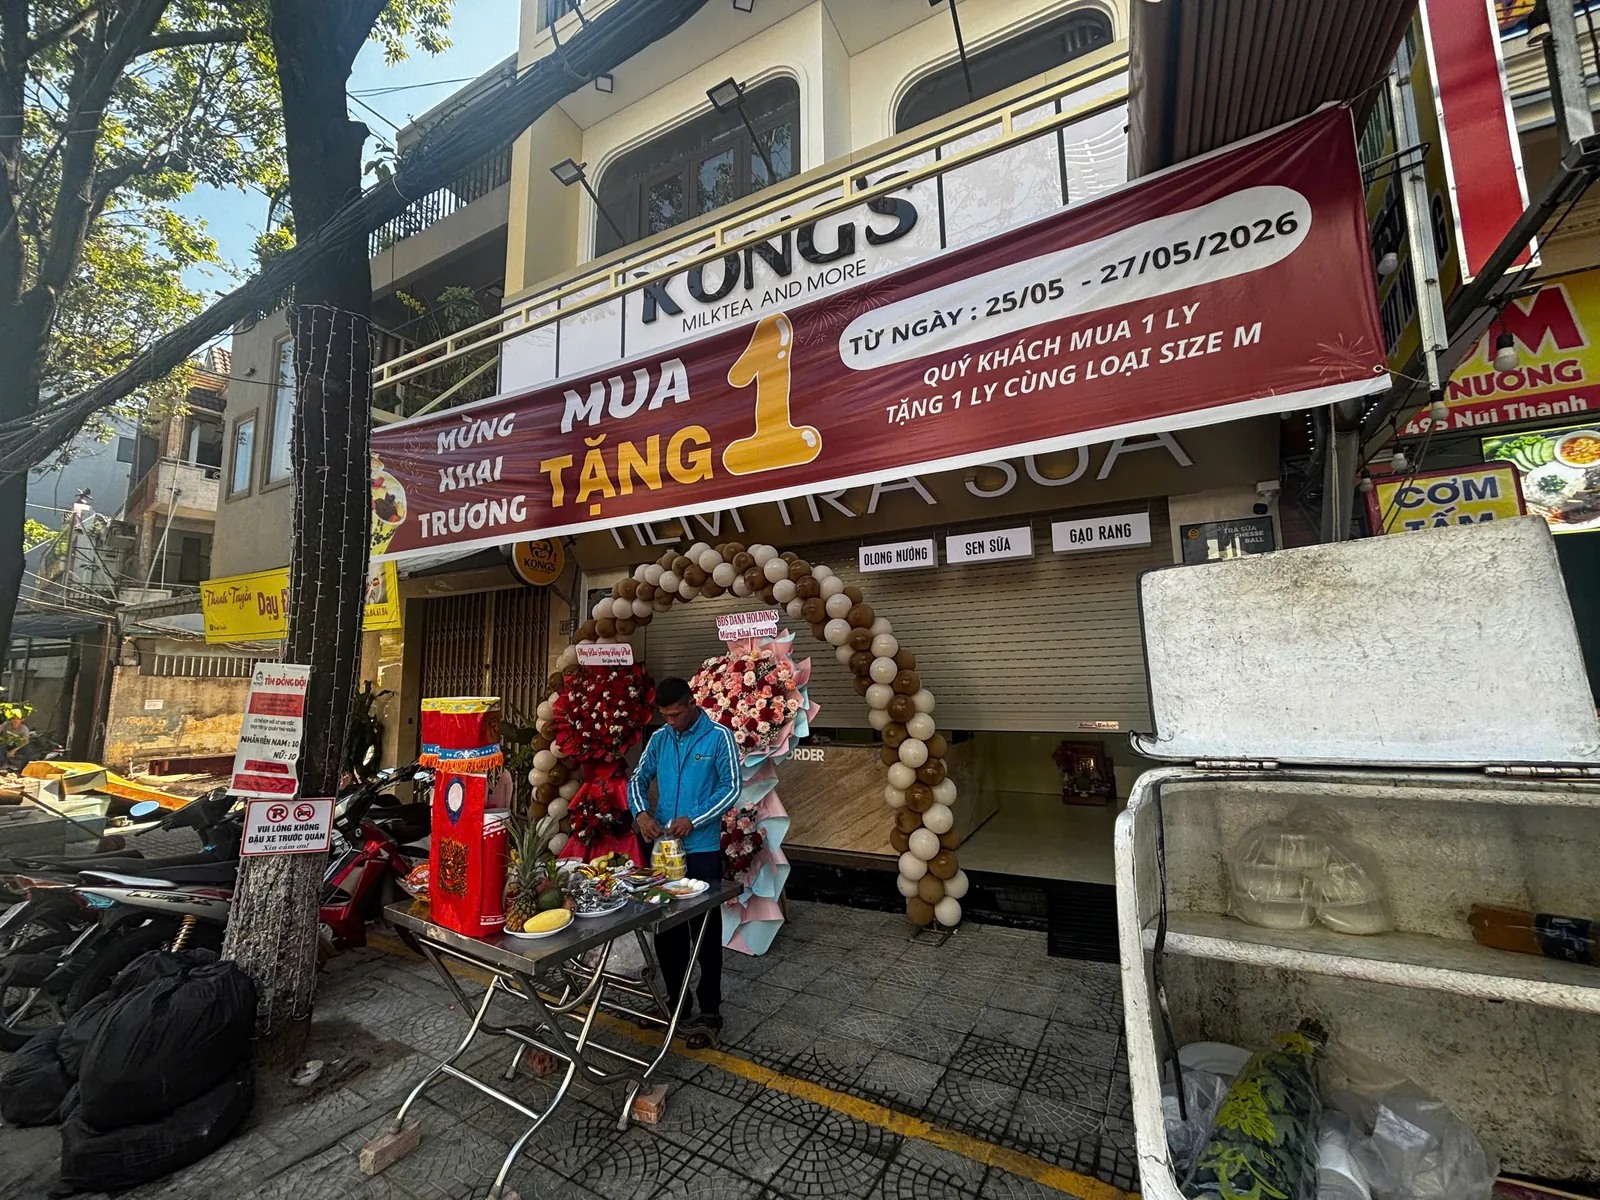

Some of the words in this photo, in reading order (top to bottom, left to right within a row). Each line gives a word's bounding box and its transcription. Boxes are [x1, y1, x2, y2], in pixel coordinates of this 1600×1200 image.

[682, 298, 753, 333] MILKTEA
[761, 281, 801, 307] AND
[807, 259, 866, 291] MORE
[849, 328, 885, 356] TỪ
[892, 306, 963, 344] NGÀY
[985, 276, 1065, 319] 25/05
[1099, 210, 1299, 283] 27/05/2026
[923, 355, 971, 388] QUÝ
[977, 331, 1063, 372] KHÁCH
[1068, 321, 1132, 352] MUA
[1142, 314, 1154, 335] 1
[1164, 302, 1201, 331] LY
[886, 393, 944, 427] TẶNG
[952, 389, 963, 410] 1
[969, 379, 1000, 407] LY
[1003, 364, 1077, 400] CÙNG
[1084, 352, 1151, 383] LOẠI
[1159, 331, 1222, 362] SIZE
[1232, 321, 1264, 350] M
[560, 357, 692, 434] MUA
[722, 312, 823, 477] 1
[436, 412, 516, 456] MỪNG
[1405, 416, 1449, 435] 495
[1454, 407, 1499, 430] Núi
[1503, 395, 1588, 422] Thành
[438, 456, 504, 494] KHAI
[539, 425, 715, 517] TẶNG
[1395, 475, 1500, 509] CƠM
[418, 494, 528, 540] TRƯƠNG
[1069, 527, 1094, 544] GẠO
[1099, 523, 1132, 540] RANG
[864, 551, 892, 567] OLONG
[896, 547, 928, 563] NƯỚNG
[965, 541, 985, 556] SEN
[990, 536, 1011, 553] SỮA
[730, 613, 746, 625] DANA
[746, 610, 778, 623] HOLDINGS
[737, 628, 752, 638] Khai
[248, 834, 264, 845] ĐẬU
[265, 835, 276, 843] XE
[304, 832, 326, 841] QUÁN
[257, 825, 270, 833] VUI
[293, 823, 320, 832] KHÔNG
